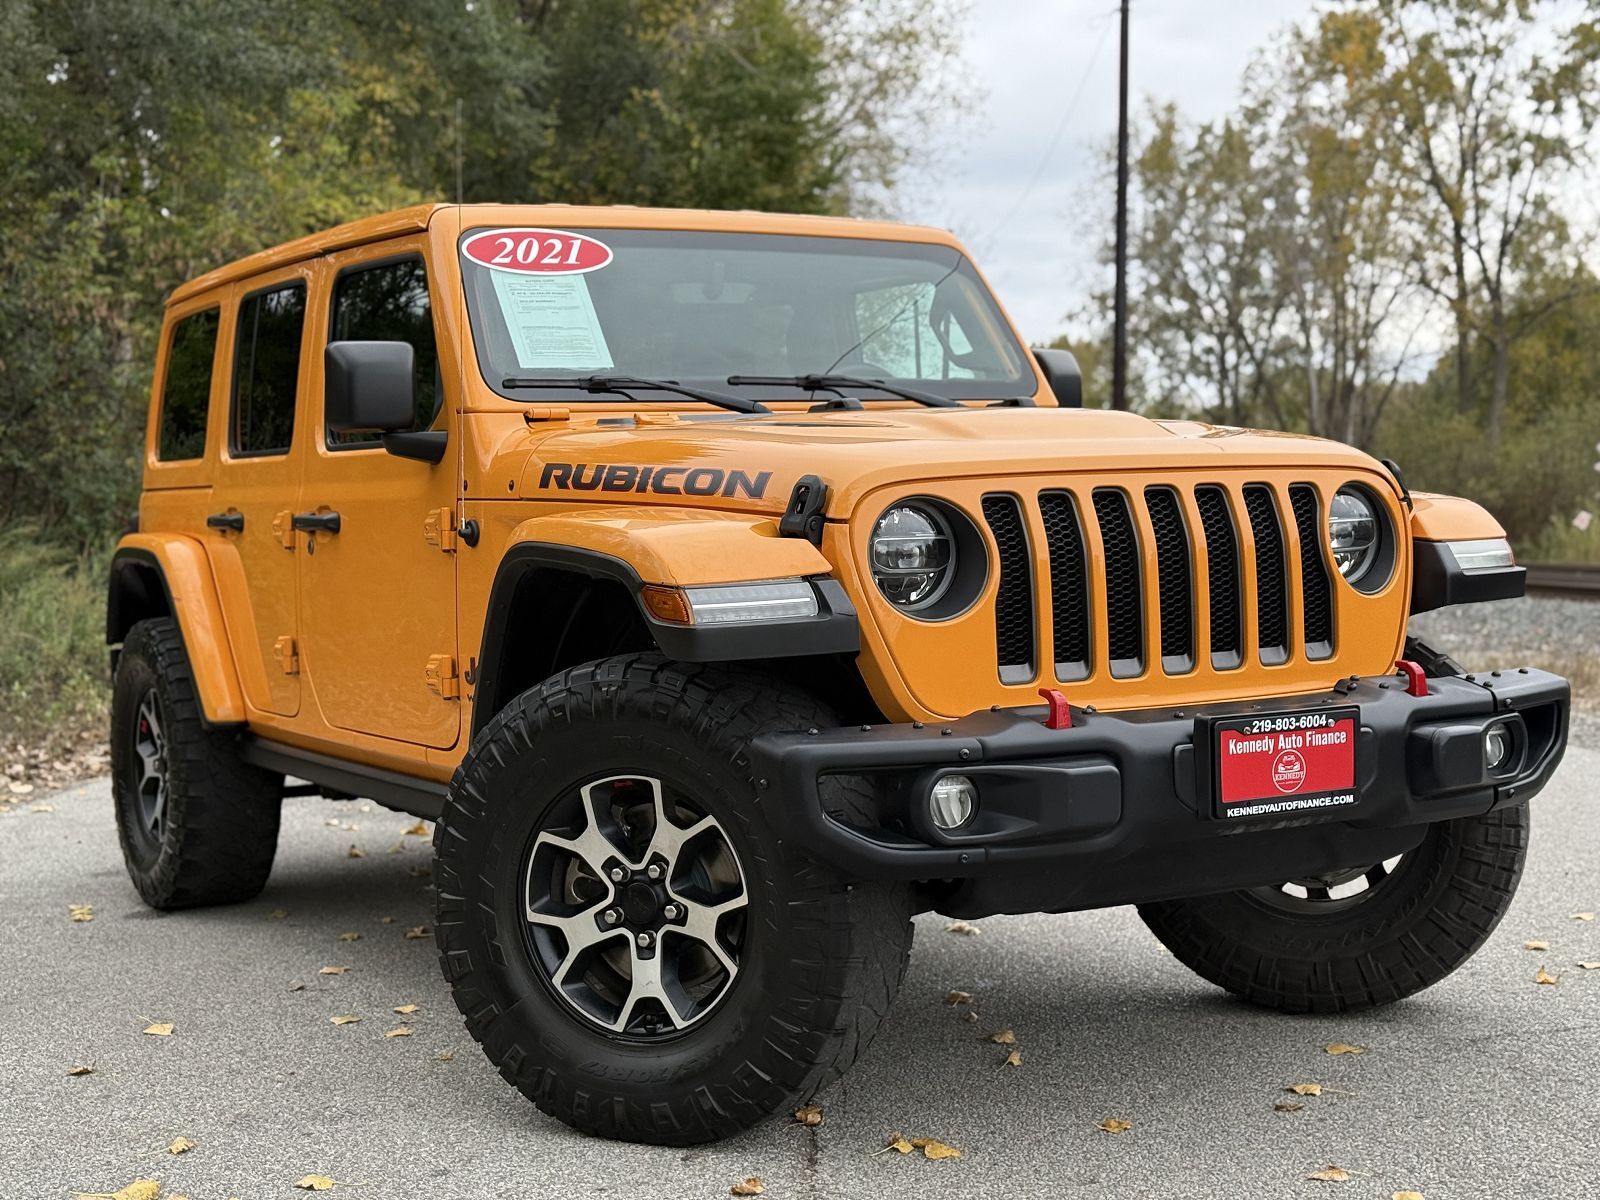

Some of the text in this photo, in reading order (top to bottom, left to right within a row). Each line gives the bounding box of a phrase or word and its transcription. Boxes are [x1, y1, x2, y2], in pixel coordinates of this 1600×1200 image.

[491, 237, 582, 264] 2021
[538, 462, 774, 500] RUBICON
[1252, 714, 1327, 733] 219-803-6004
[1229, 731, 1347, 755] Kennedy Auto Finance
[1227, 794, 1354, 818] KENNEDYAUTOFINANCE.COM
